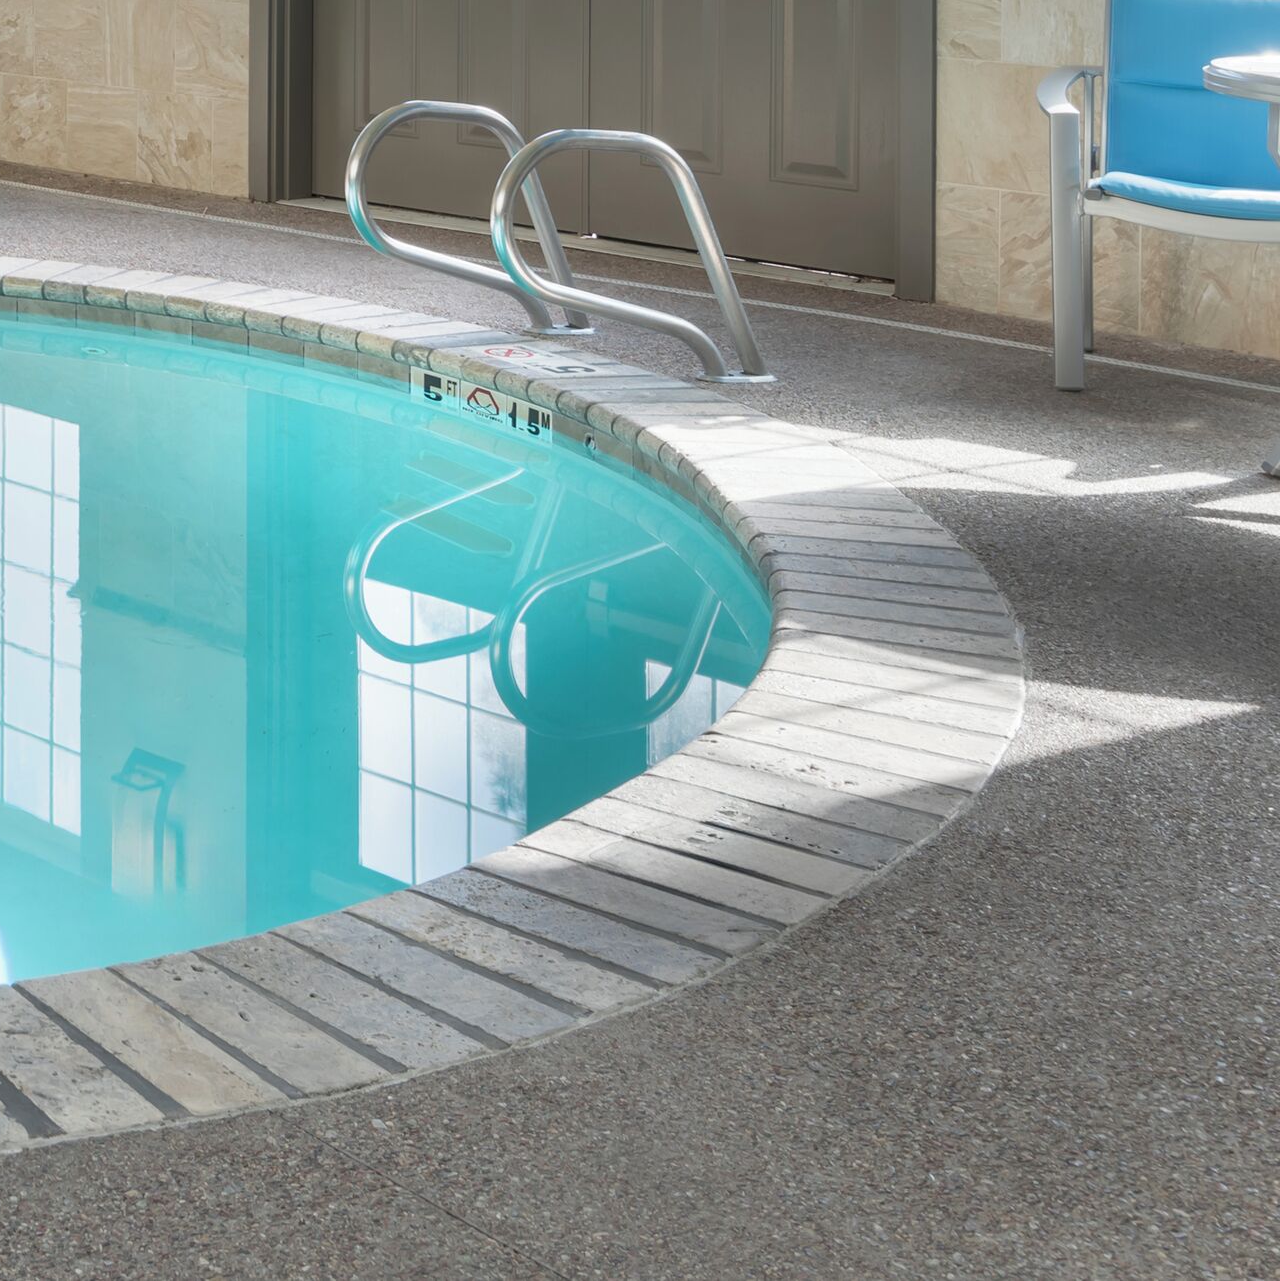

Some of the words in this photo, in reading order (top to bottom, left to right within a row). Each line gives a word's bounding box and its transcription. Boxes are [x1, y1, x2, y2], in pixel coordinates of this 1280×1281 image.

[541, 365, 596, 374] 5
[424, 373, 442, 401] 5
[446, 380, 457, 398] FT
[508, 402, 540, 435] 1.5
[541, 412, 551, 431] M
